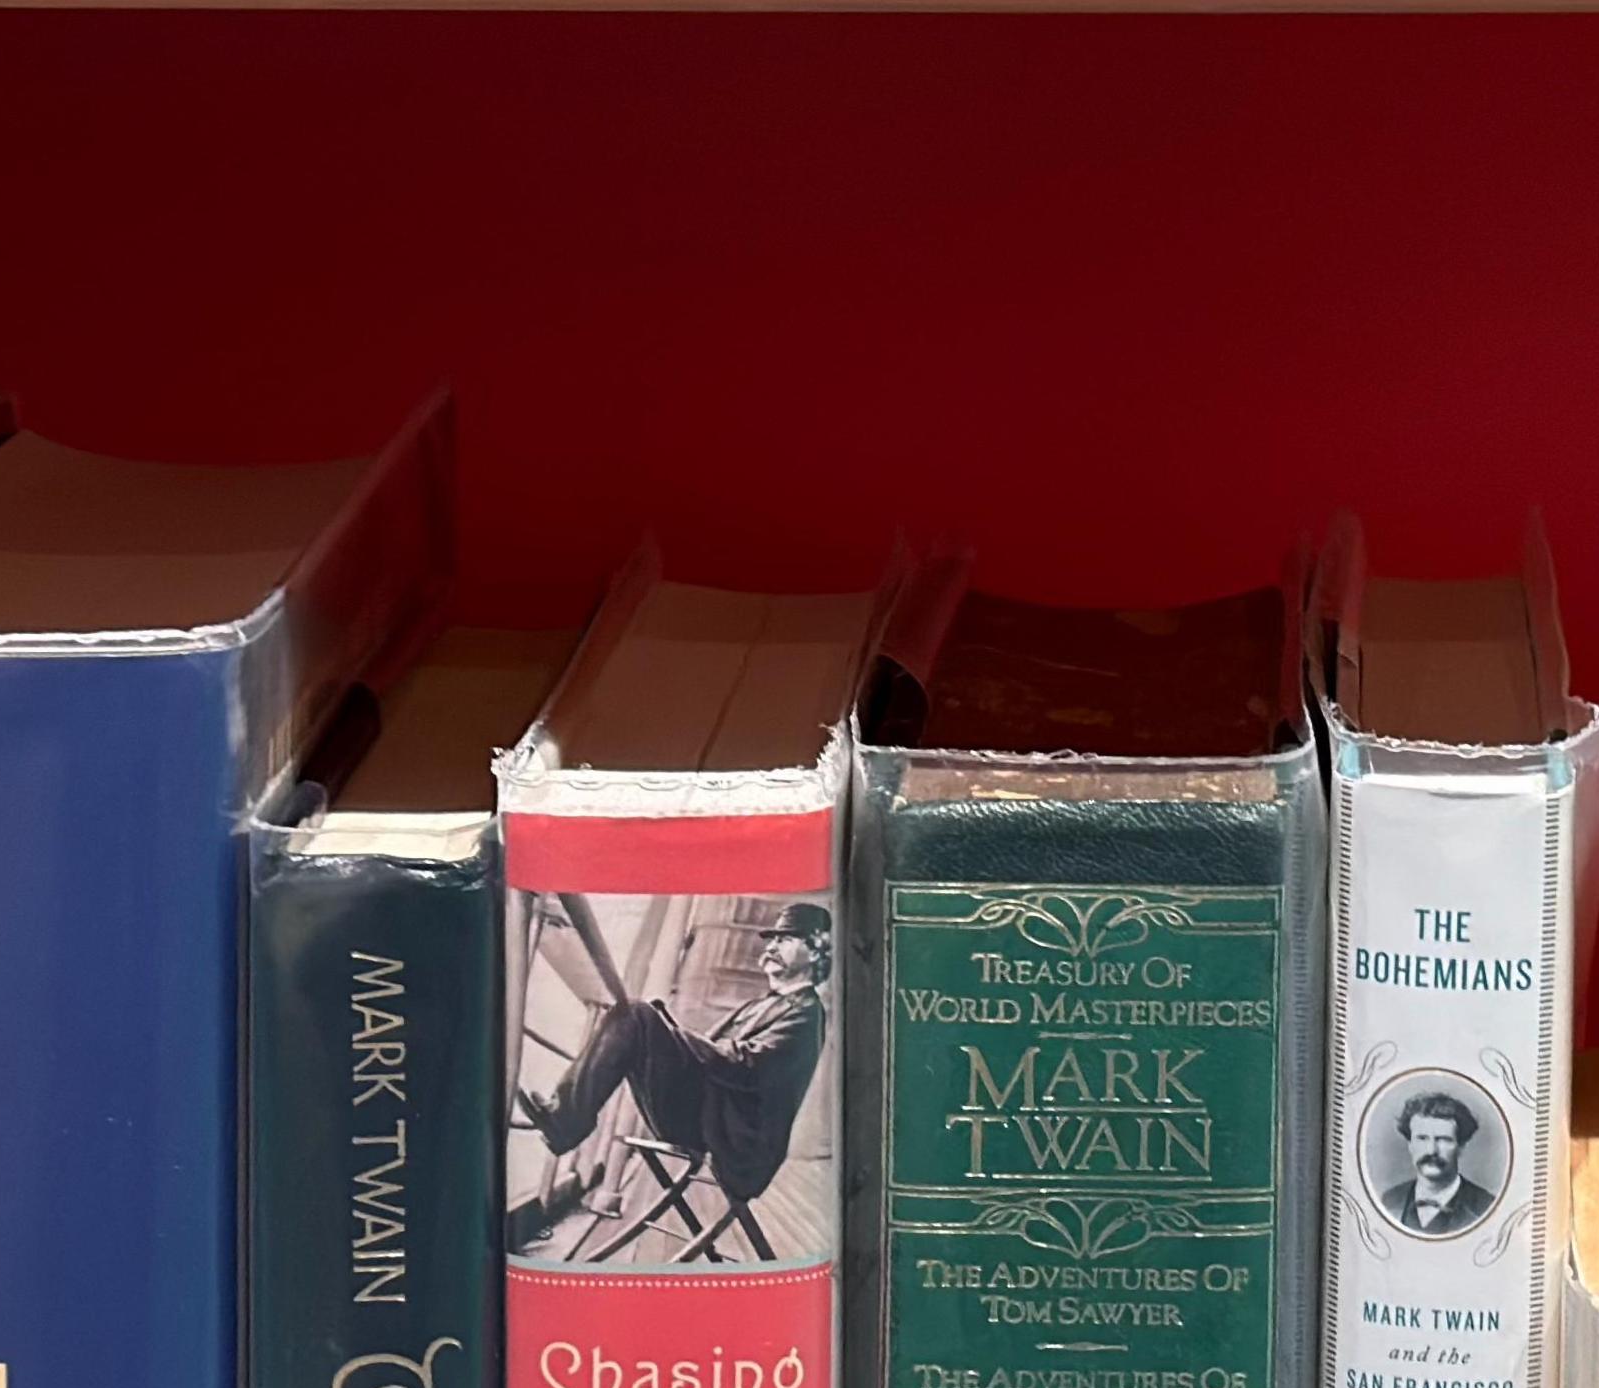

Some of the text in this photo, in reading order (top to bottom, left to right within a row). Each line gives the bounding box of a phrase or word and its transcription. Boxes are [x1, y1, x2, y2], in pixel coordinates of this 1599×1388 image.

[1414, 909, 1471, 943] THE
[970, 953, 1192, 988] TREASURY OF
[1355, 948, 1533, 991] BOHEMIANS
[900, 989, 1271, 1027] WORLD MASTERPIECES
[960, 1046, 1207, 1111] MARK
[350, 951, 406, 1303] MARK TWAIN
[946, 1114, 1212, 1178] TWAIN
[916, 1260, 1249, 1292] THE ADVENTURES OF
[980, 1296, 1184, 1327] TOM SAWYER
[1363, 1301, 1500, 1331] MARK TWAIN
[1388, 1346, 1471, 1365] and the
